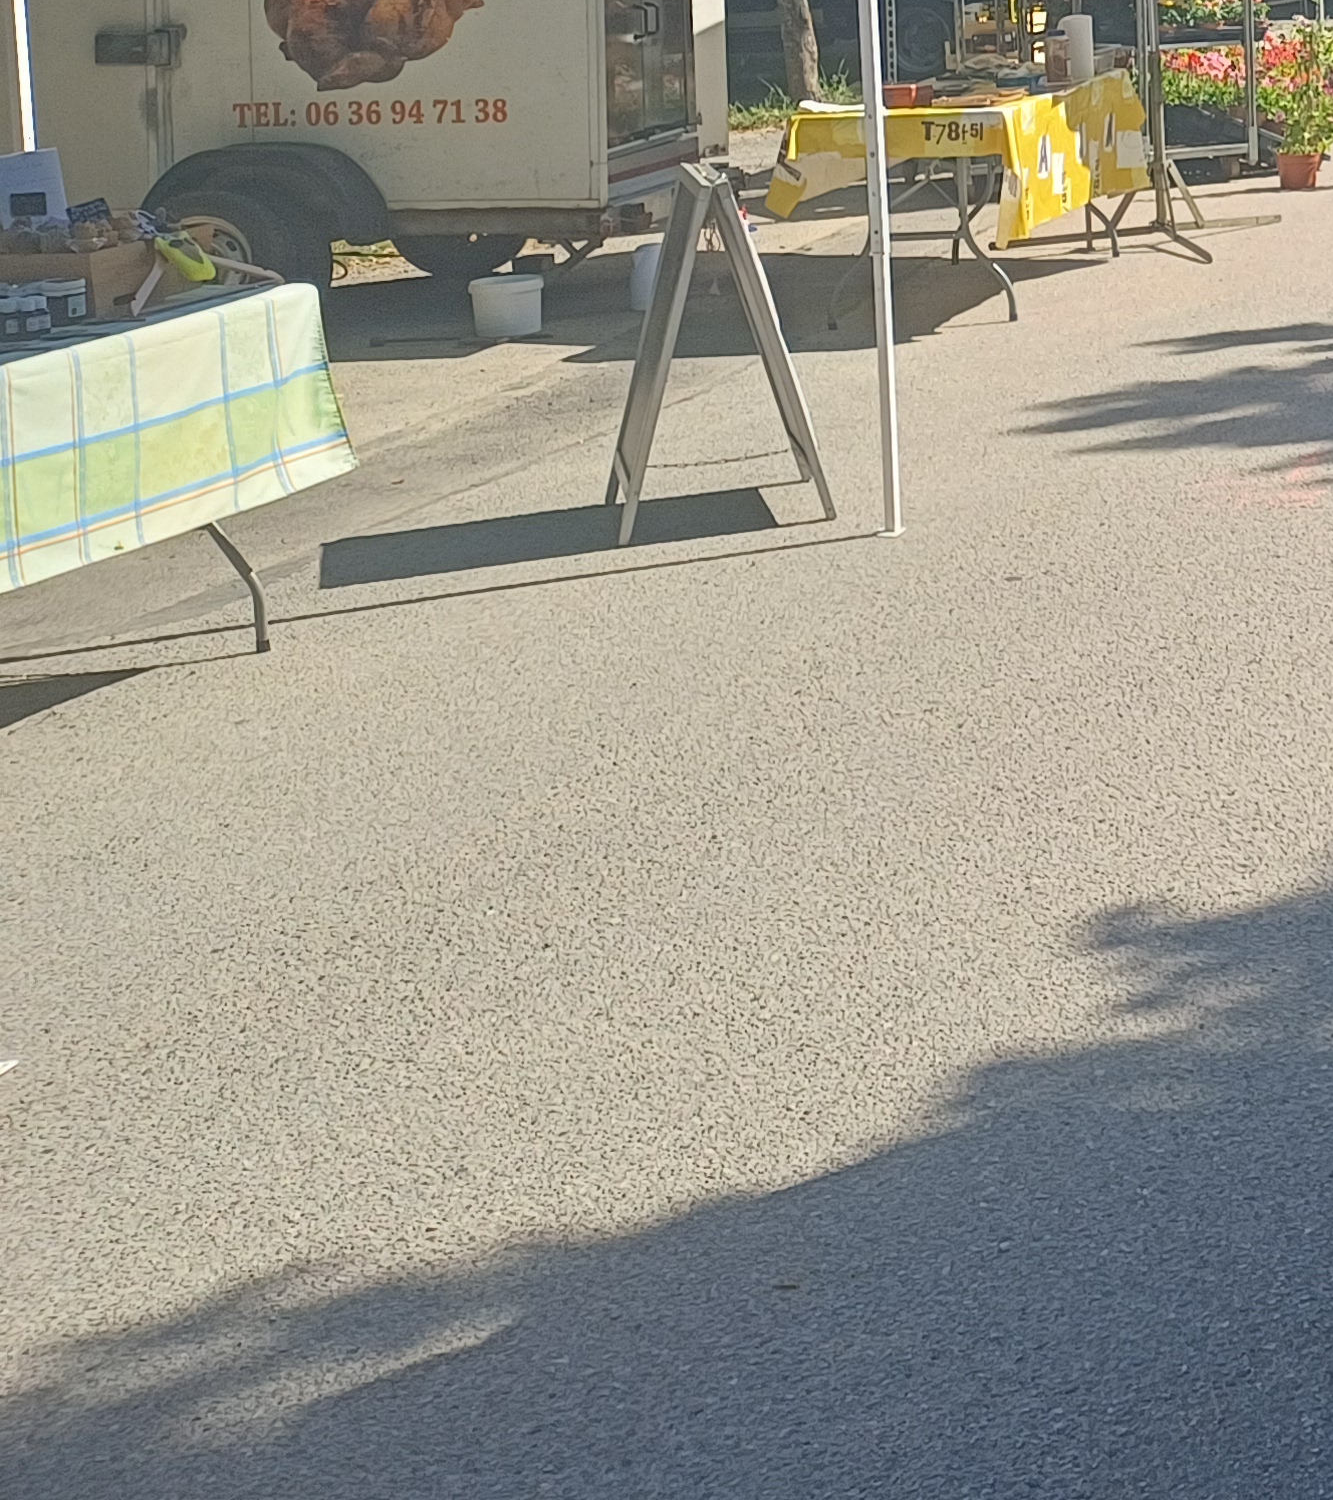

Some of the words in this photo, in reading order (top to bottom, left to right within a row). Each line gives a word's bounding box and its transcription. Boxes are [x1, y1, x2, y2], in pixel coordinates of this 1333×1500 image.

[232, 102, 297, 128] TEL:
[305, 101, 339, 126] 06
[348, 100, 382, 125] 36
[390, 100, 425, 124] 94
[432, 99, 466, 124] 71
[475, 98, 508, 123] 38
